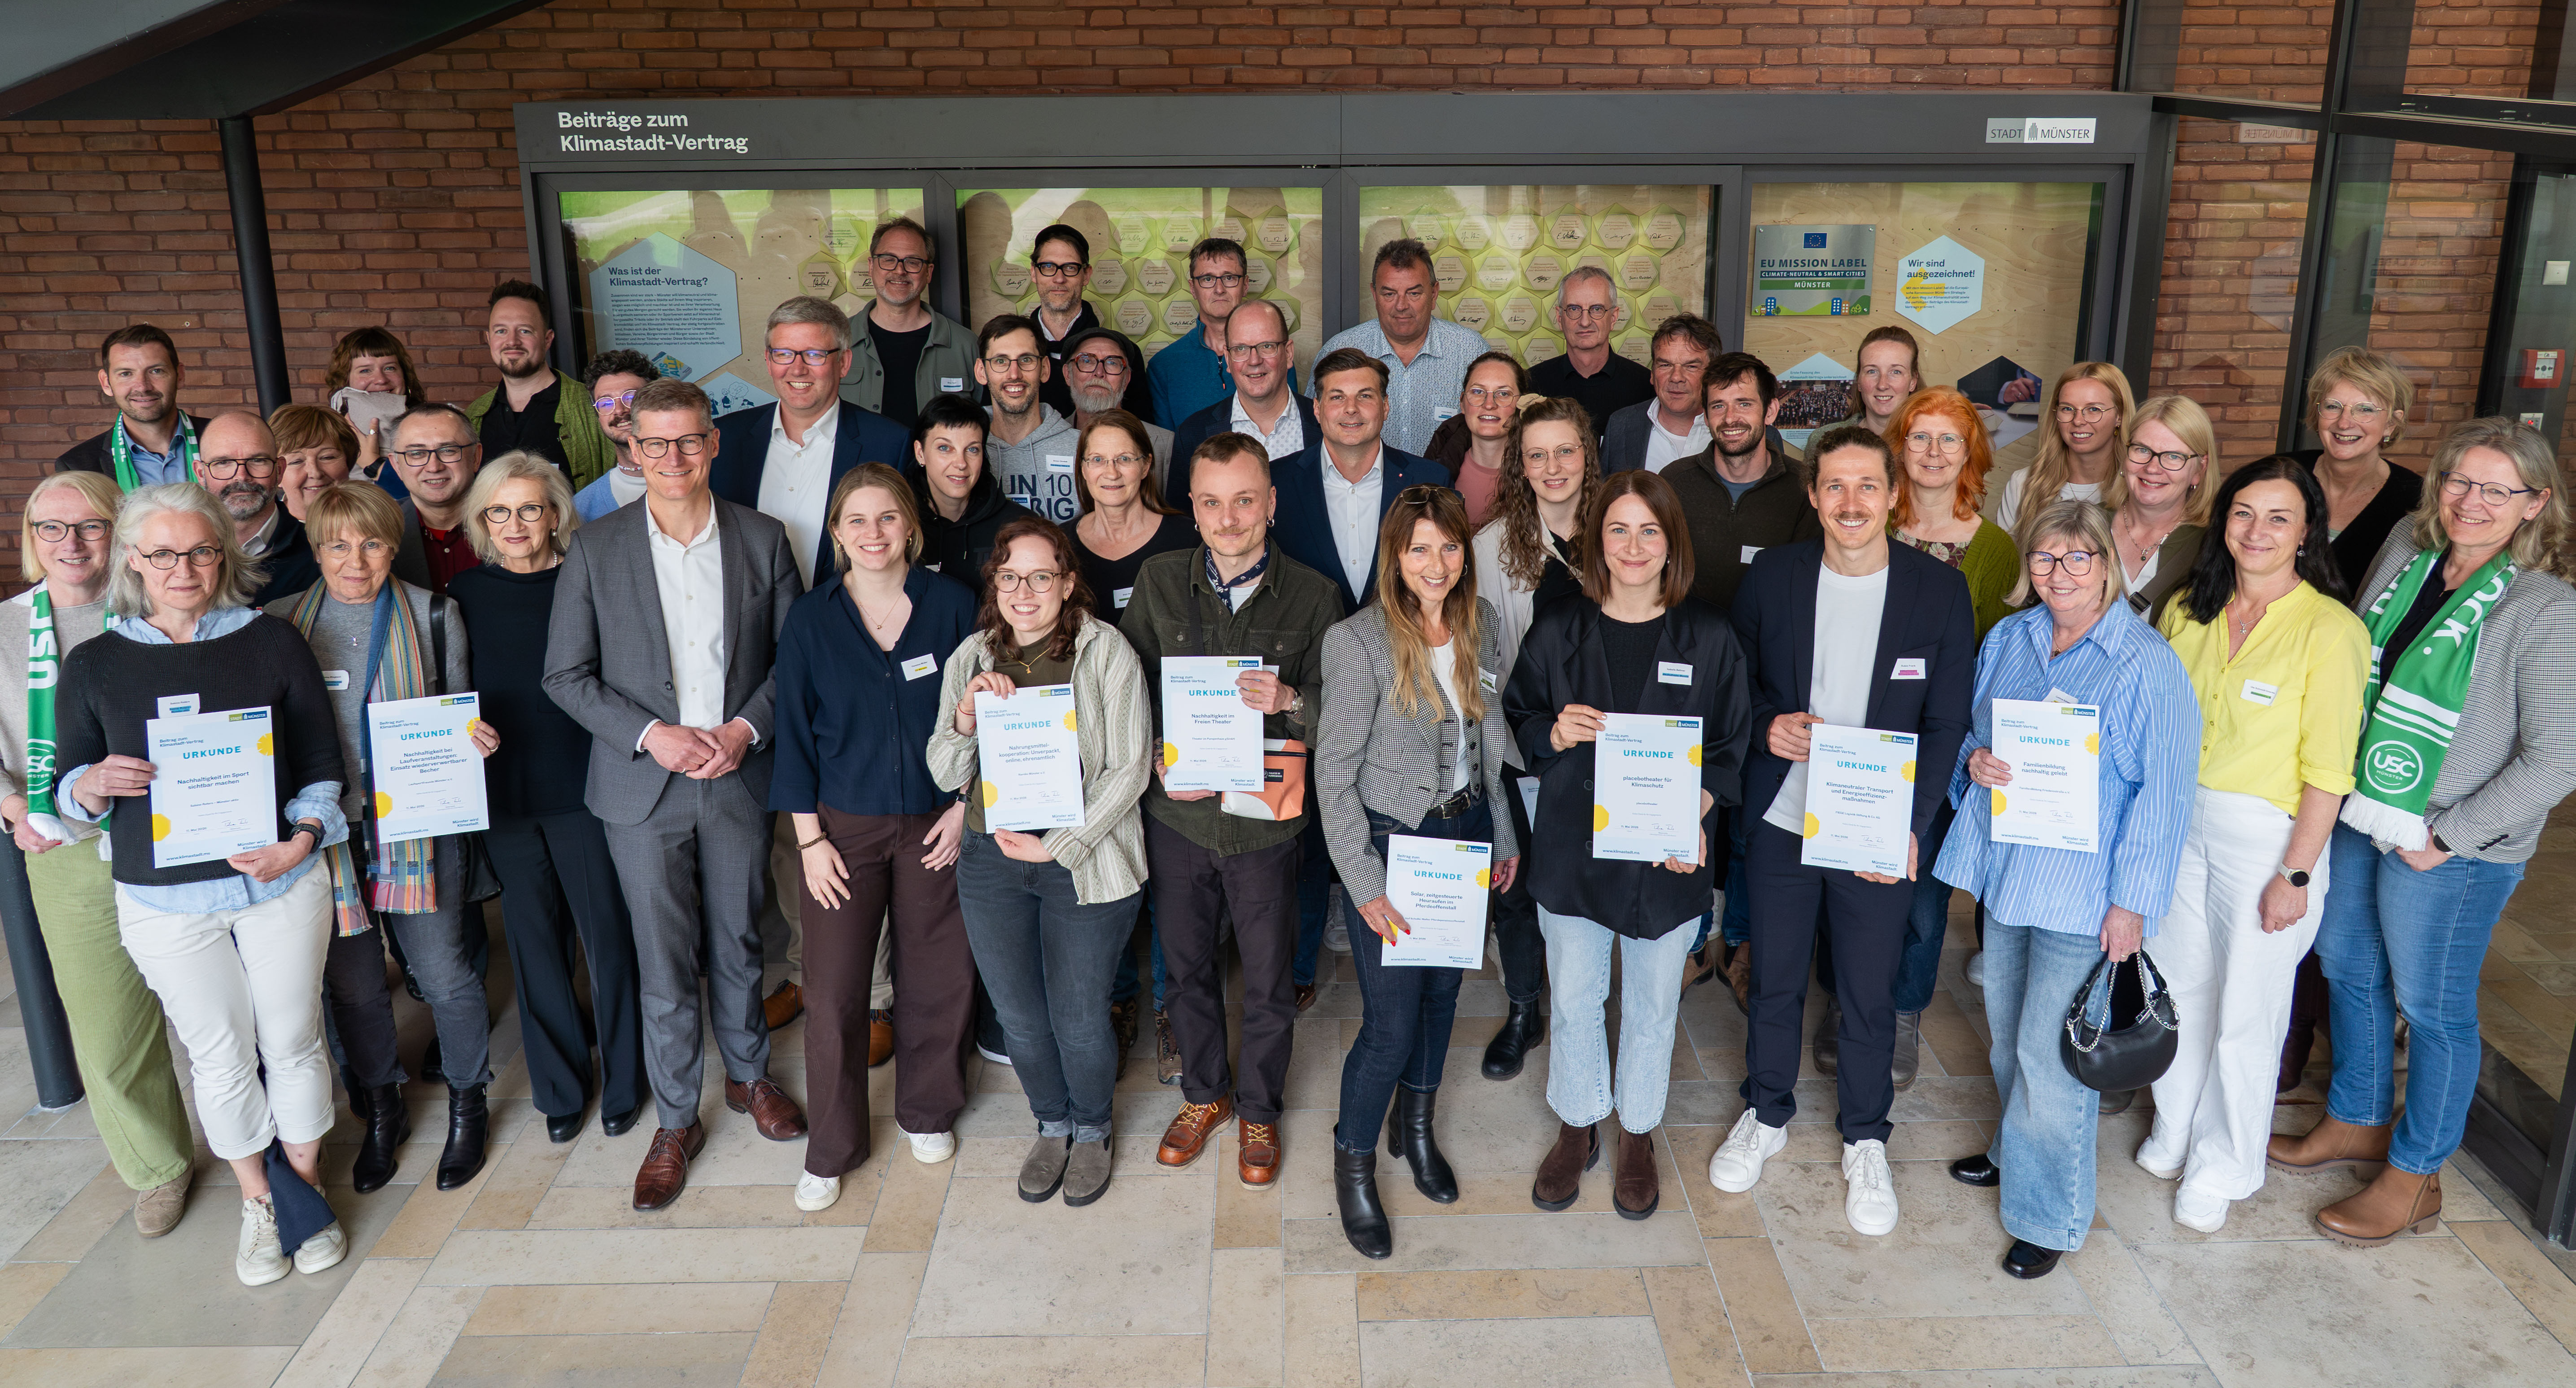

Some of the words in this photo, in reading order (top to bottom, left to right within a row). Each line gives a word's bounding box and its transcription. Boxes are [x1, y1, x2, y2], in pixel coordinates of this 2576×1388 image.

[558, 111, 642, 131] Beiträge
[646, 115, 688, 127] zum
[1991, 128, 2023, 138] STADT
[2041, 128, 2090, 138] MÜNSTER
[560, 134, 748, 154] Klimastadt-Vertrag
[1761, 259, 1775, 267] EU
[1779, 259, 1828, 267] MISSION
[1832, 259, 1866, 267] LABEL
[1907, 270, 1975, 280] ausgezeichnet!
[610, 277, 707, 287] Klimastadt-Vertrag?
[1000, 475, 1037, 496] UN
[1046, 474, 1072, 496] 10
[1004, 721, 1051, 730] URKUNDE
[401, 729, 452, 740] URKUNDE
[2020, 736, 2070, 746] URKUNDE
[183, 746, 241, 759] URKUNDE
[404, 749, 443, 757] Nachhaltigkeit
[1624, 750, 1673, 758] URKUNDE
[400, 754, 457, 764] Laufveranstaltungen:
[411, 759, 467, 768] wiederverwertbarer
[2374, 751, 2416, 777] USC
[1838, 761, 1886, 772] URKUNDE
[2024, 762, 2065, 771] Familienbildung
[178, 775, 222, 784] Nachhaltigkeit
[2376, 770, 2403, 780] MÜNSTER
[1826, 782, 1865, 790] Klimaneutraler
[1842, 790, 1887, 799] Energieeffizienz-
[1415, 870, 1462, 880] URKUNDE
